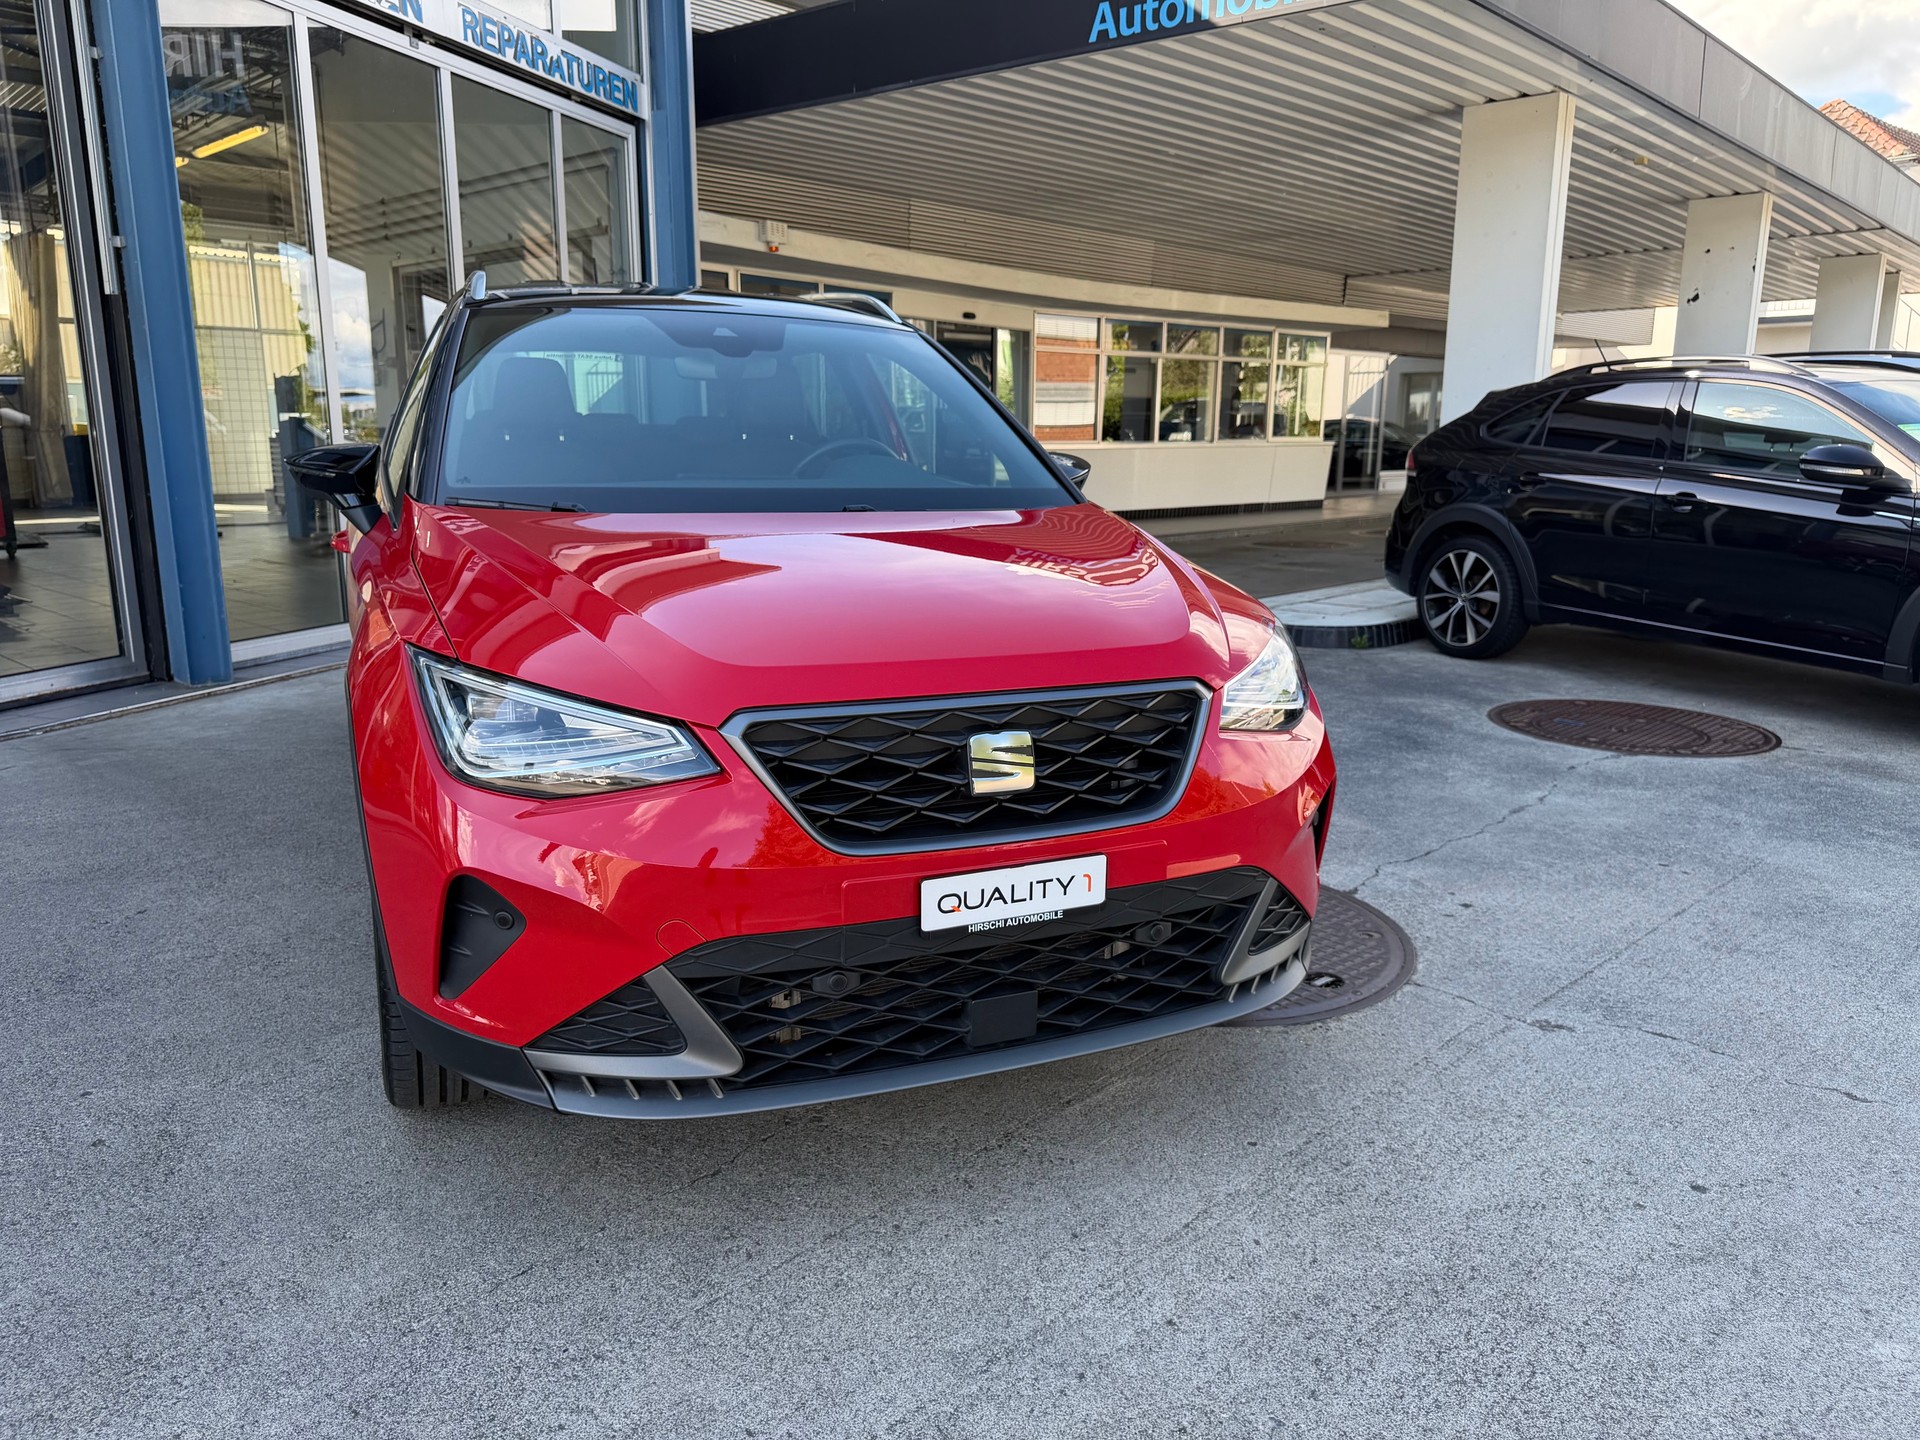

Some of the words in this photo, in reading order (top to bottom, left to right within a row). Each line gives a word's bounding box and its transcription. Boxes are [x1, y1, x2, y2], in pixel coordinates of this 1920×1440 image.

[461, 5, 639, 113] REPARATUREN
[937, 875, 1076, 914] QUALITY
[1083, 873, 1092, 892] 1
[968, 920, 1005, 933] HIRSCHI
[1006, 910, 1064, 927] AUTOMOBILE
